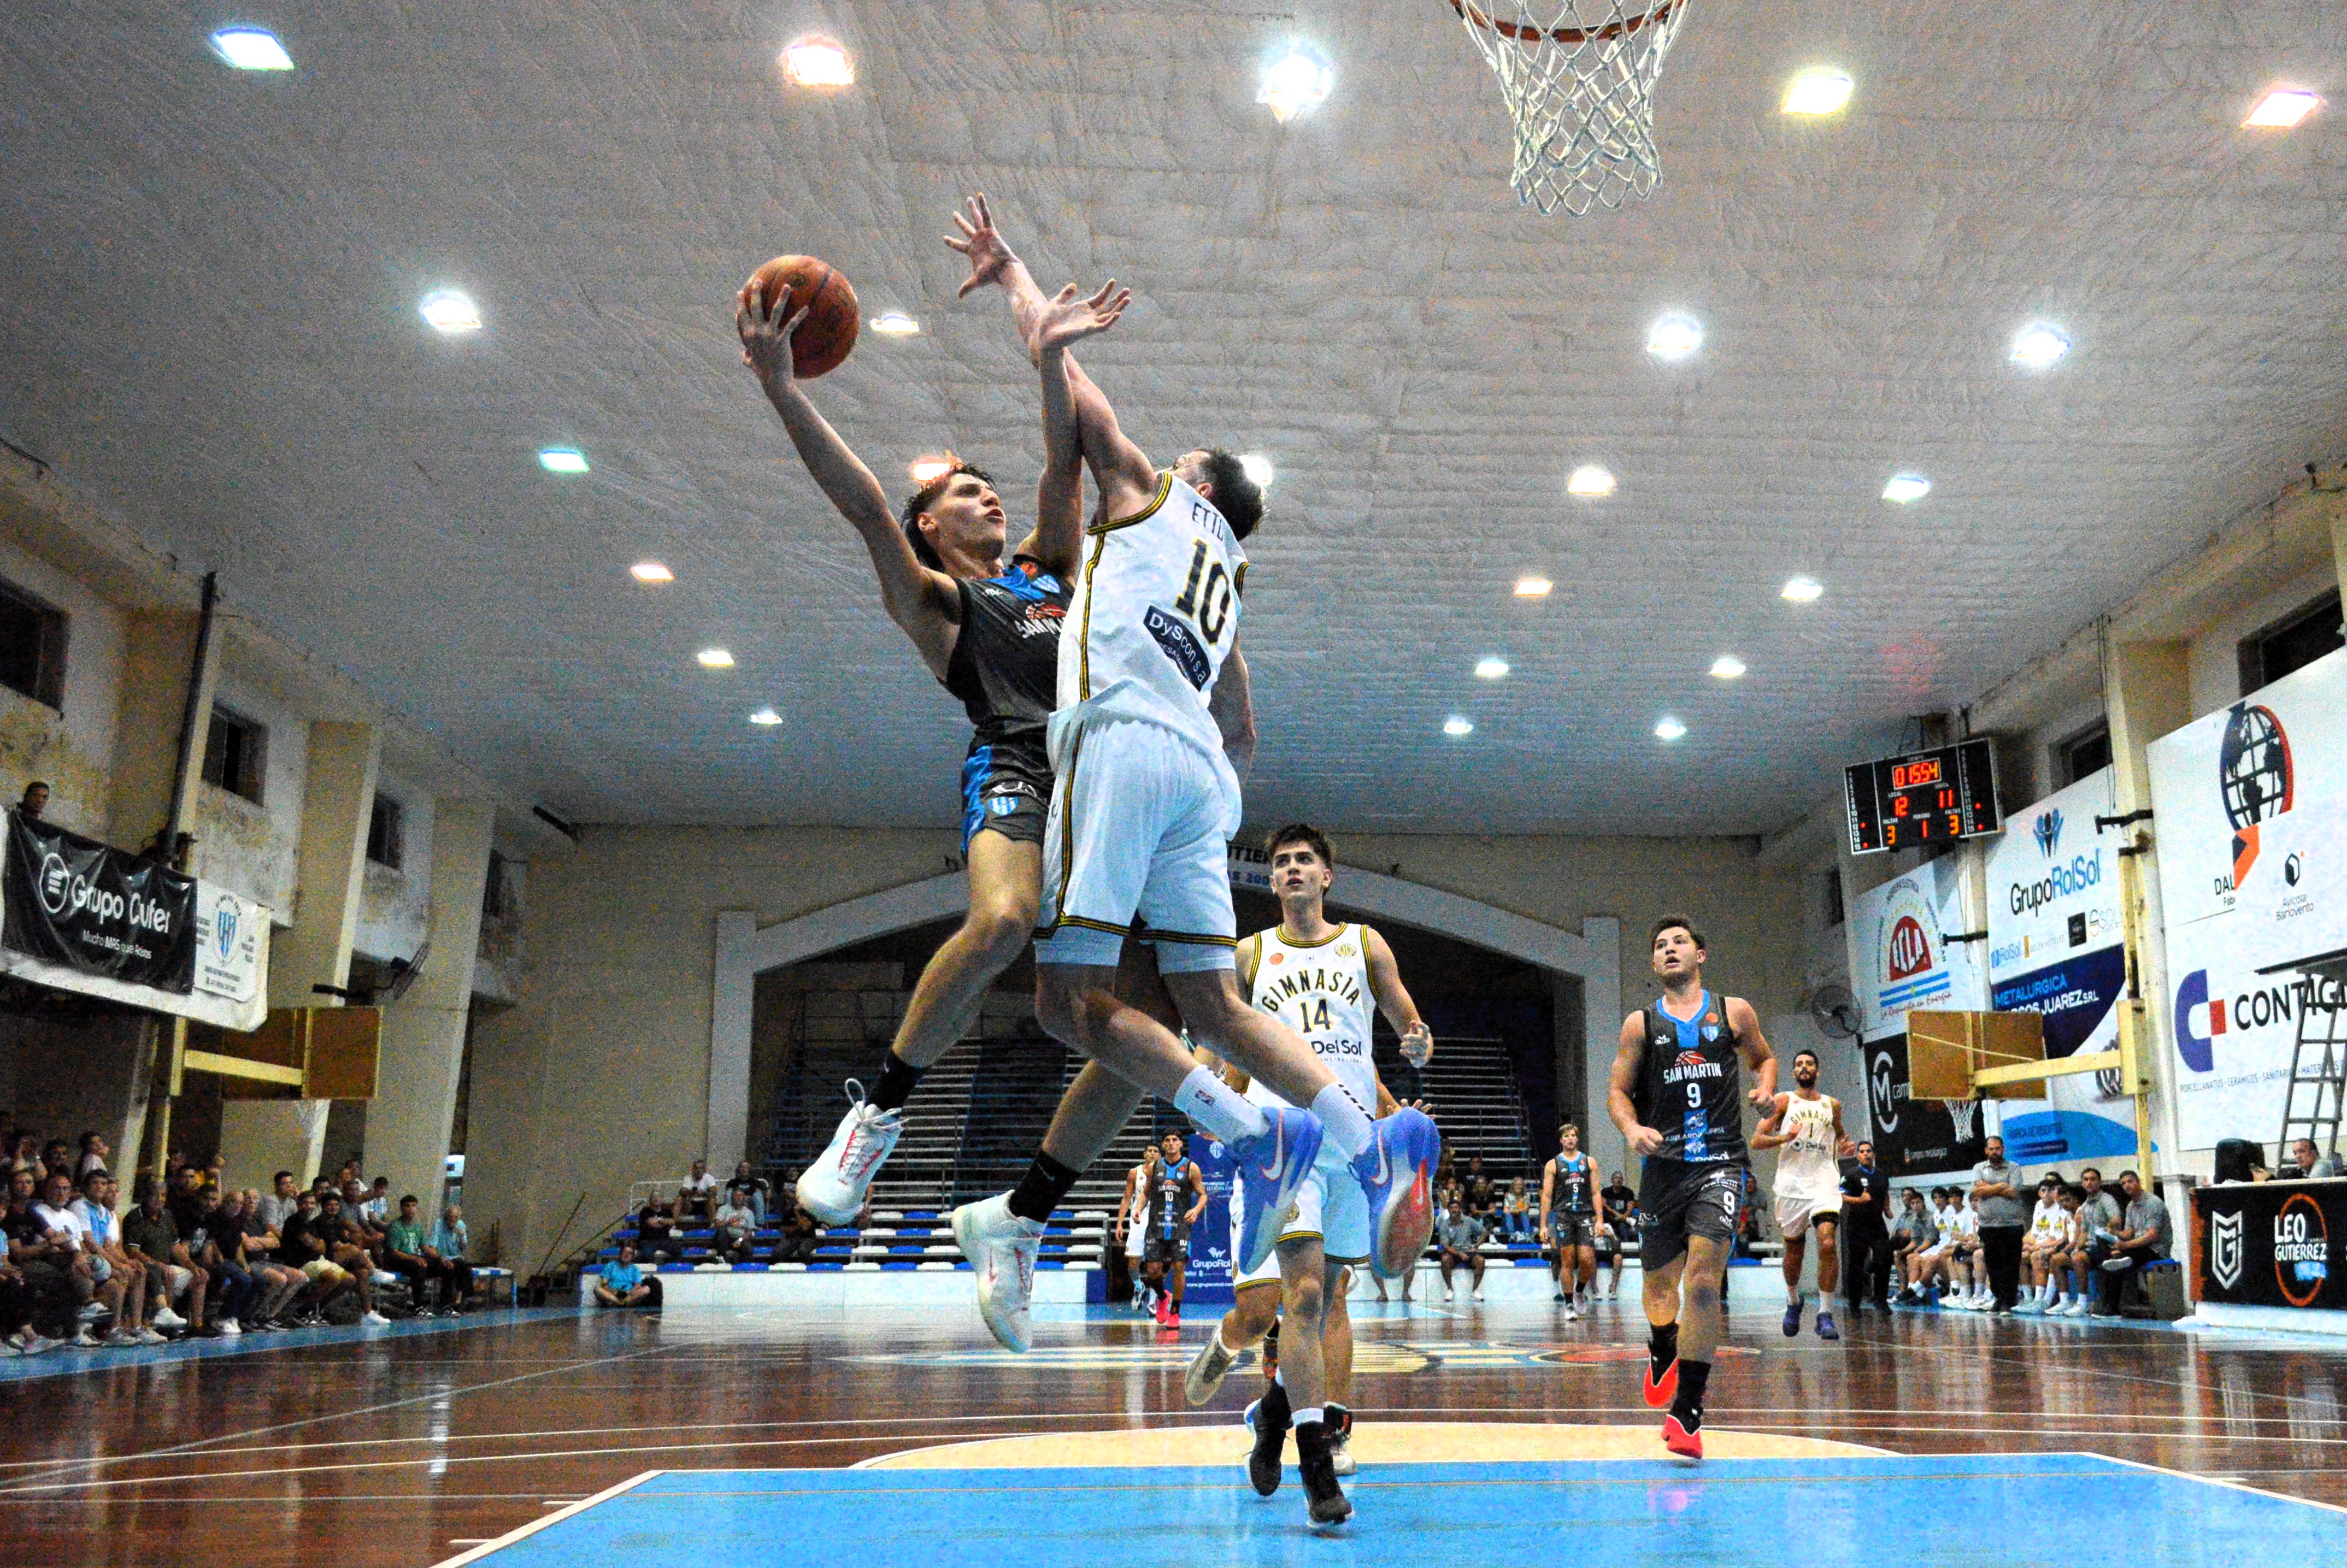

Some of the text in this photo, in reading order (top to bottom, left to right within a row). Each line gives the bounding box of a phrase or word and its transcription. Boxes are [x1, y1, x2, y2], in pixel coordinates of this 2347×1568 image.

[1174, 537, 1231, 646] 10
[1895, 789, 1954, 817] 12 11
[1887, 814, 1960, 845] 3 1 3
[2010, 848, 2101, 918] GrupoRolSol
[72, 874, 124, 924] Grupo
[130, 893, 170, 934] Cufer
[1261, 968, 1361, 1012] GIMNASIA
[1995, 973, 2068, 1007] METALURGICA
[2042, 989, 2083, 1016] JUAREZ
[2083, 990, 2099, 1004] SRL
[1299, 997, 1332, 1034] 14
[1319, 1057, 1363, 1065] NSTRUCTORA
[1663, 1063, 1722, 1084] SAN MARTIN
[2262, 1068, 2297, 1082] SANITARI
[1686, 1082, 1702, 1108] 9
[1790, 1109, 1831, 1128] GIMNASIA
[1809, 1122, 1814, 1138] 1
[1665, 1133, 1702, 1142] ABELARDO
[1164, 1192, 1174, 1202] 10
[1573, 1183, 1579, 1193] 5
[1724, 1191, 1735, 1215] 9
[2274, 1213, 2306, 1243] LEO
[1192, 1259, 1231, 1270] GrupoRol
[2275, 1243, 2328, 1262] GUTIERREZ
